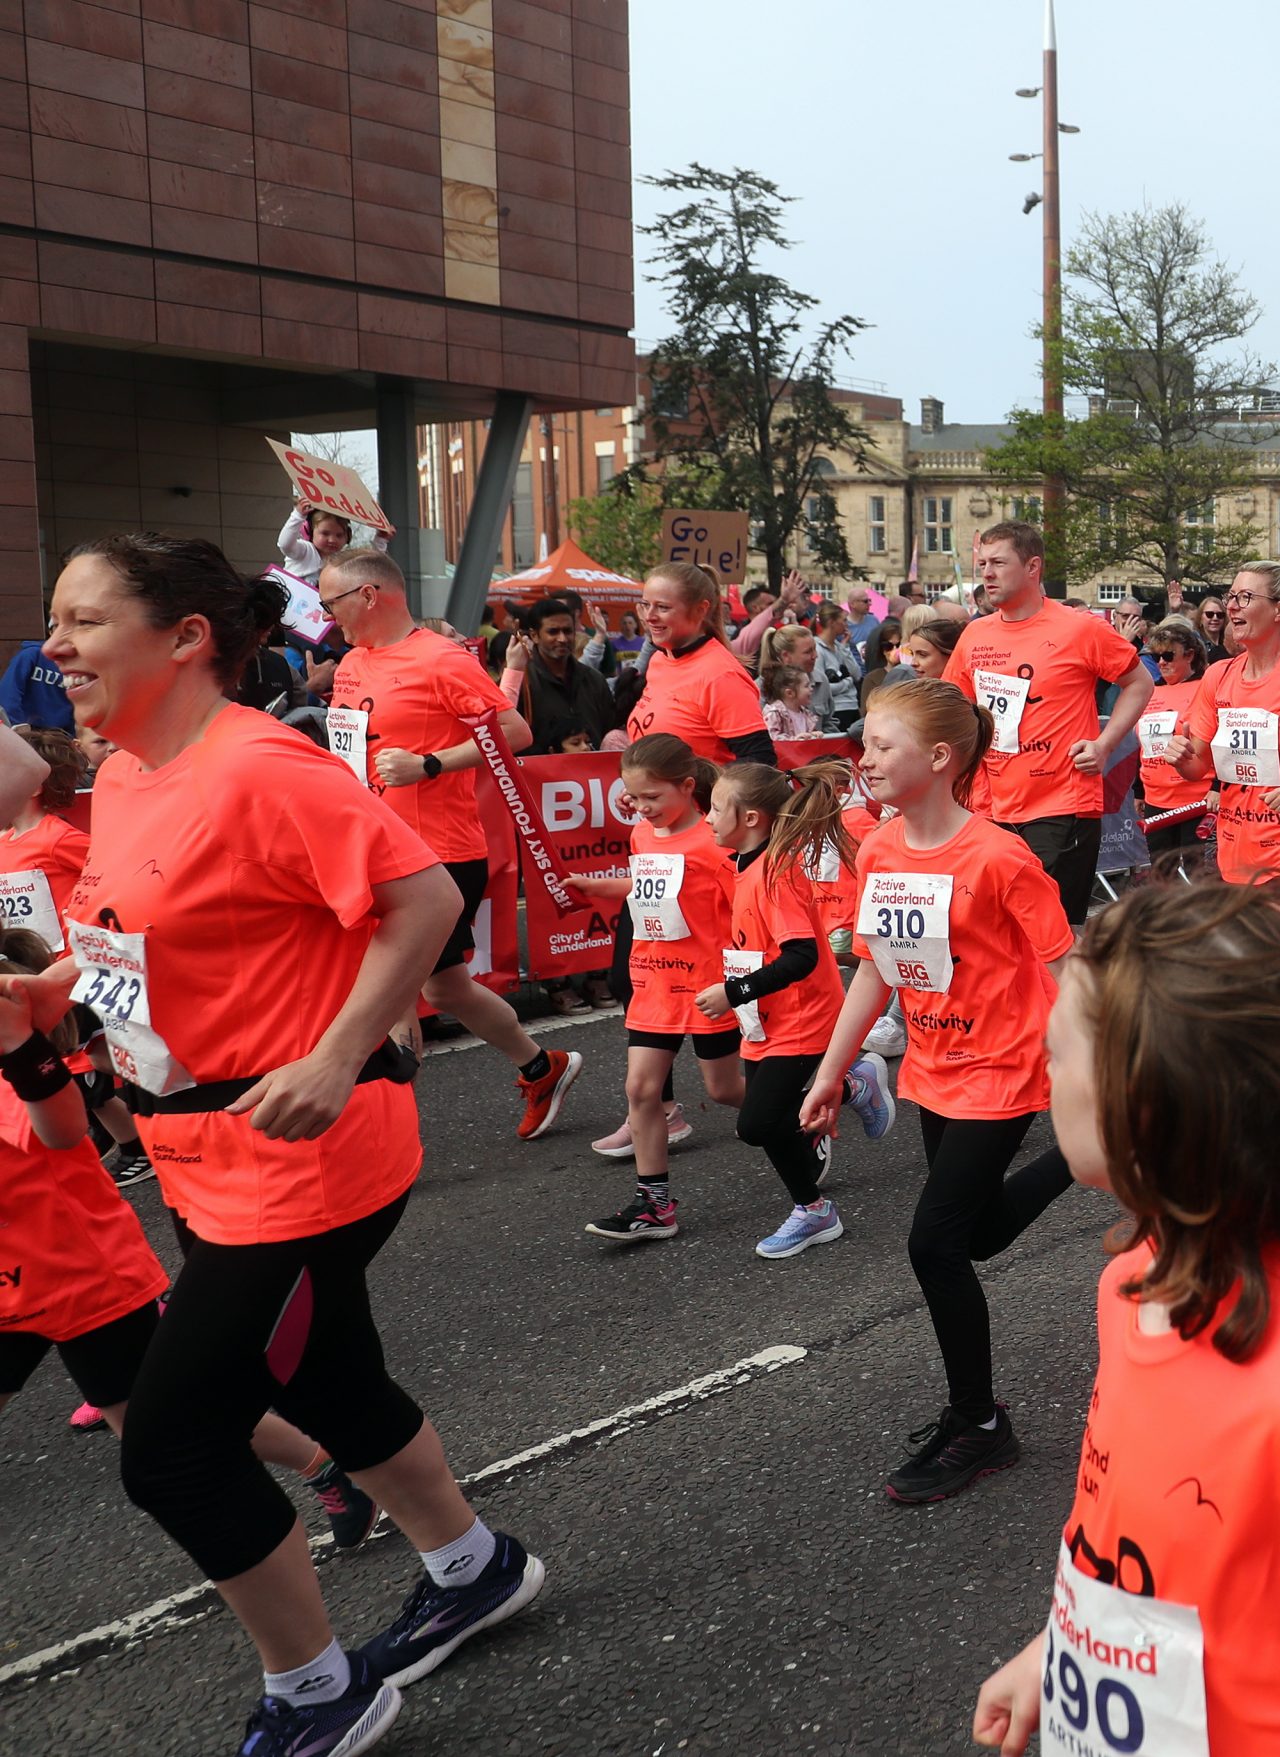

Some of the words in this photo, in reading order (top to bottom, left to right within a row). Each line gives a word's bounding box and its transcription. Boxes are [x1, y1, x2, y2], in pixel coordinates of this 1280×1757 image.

[285, 451, 336, 487] Go
[671, 516, 708, 542] Go
[971, 652, 1012, 660] Sunderland
[978, 675, 1003, 685] Active
[978, 683, 1021, 698] Sunderland
[986, 694, 1008, 714] 79
[1225, 720, 1269, 729] Sunderland
[334, 731, 353, 752] 321
[1019, 740, 1052, 753] ivity
[1151, 743, 1164, 752] BIG
[1229, 729, 1257, 750] 311
[474, 724, 536, 836] FOUNDATION
[1235, 764, 1258, 777] BIG
[1145, 800, 1207, 825] FOUNDATION
[1100, 830, 1135, 843] derland
[526, 838, 552, 870] SKY
[636, 866, 673, 876] nderland
[0, 883, 35, 895] nderland
[634, 878, 666, 900] 309
[873, 879, 906, 891] Active
[871, 892, 935, 906] Sunderland
[644, 919, 663, 932] BIG
[876, 908, 925, 939] 310
[549, 931, 571, 947] City
[572, 929, 585, 940] of
[550, 934, 612, 955] Sunderland
[889, 940, 919, 950] AMIRA
[896, 962, 930, 981] BIG
[83, 967, 141, 1021] 543
[911, 1008, 975, 1034] Activity
[1080, 1473, 1100, 1502] un
[1053, 1600, 1157, 1677] nderland
[1047, 1716, 1113, 1757] ARTH
